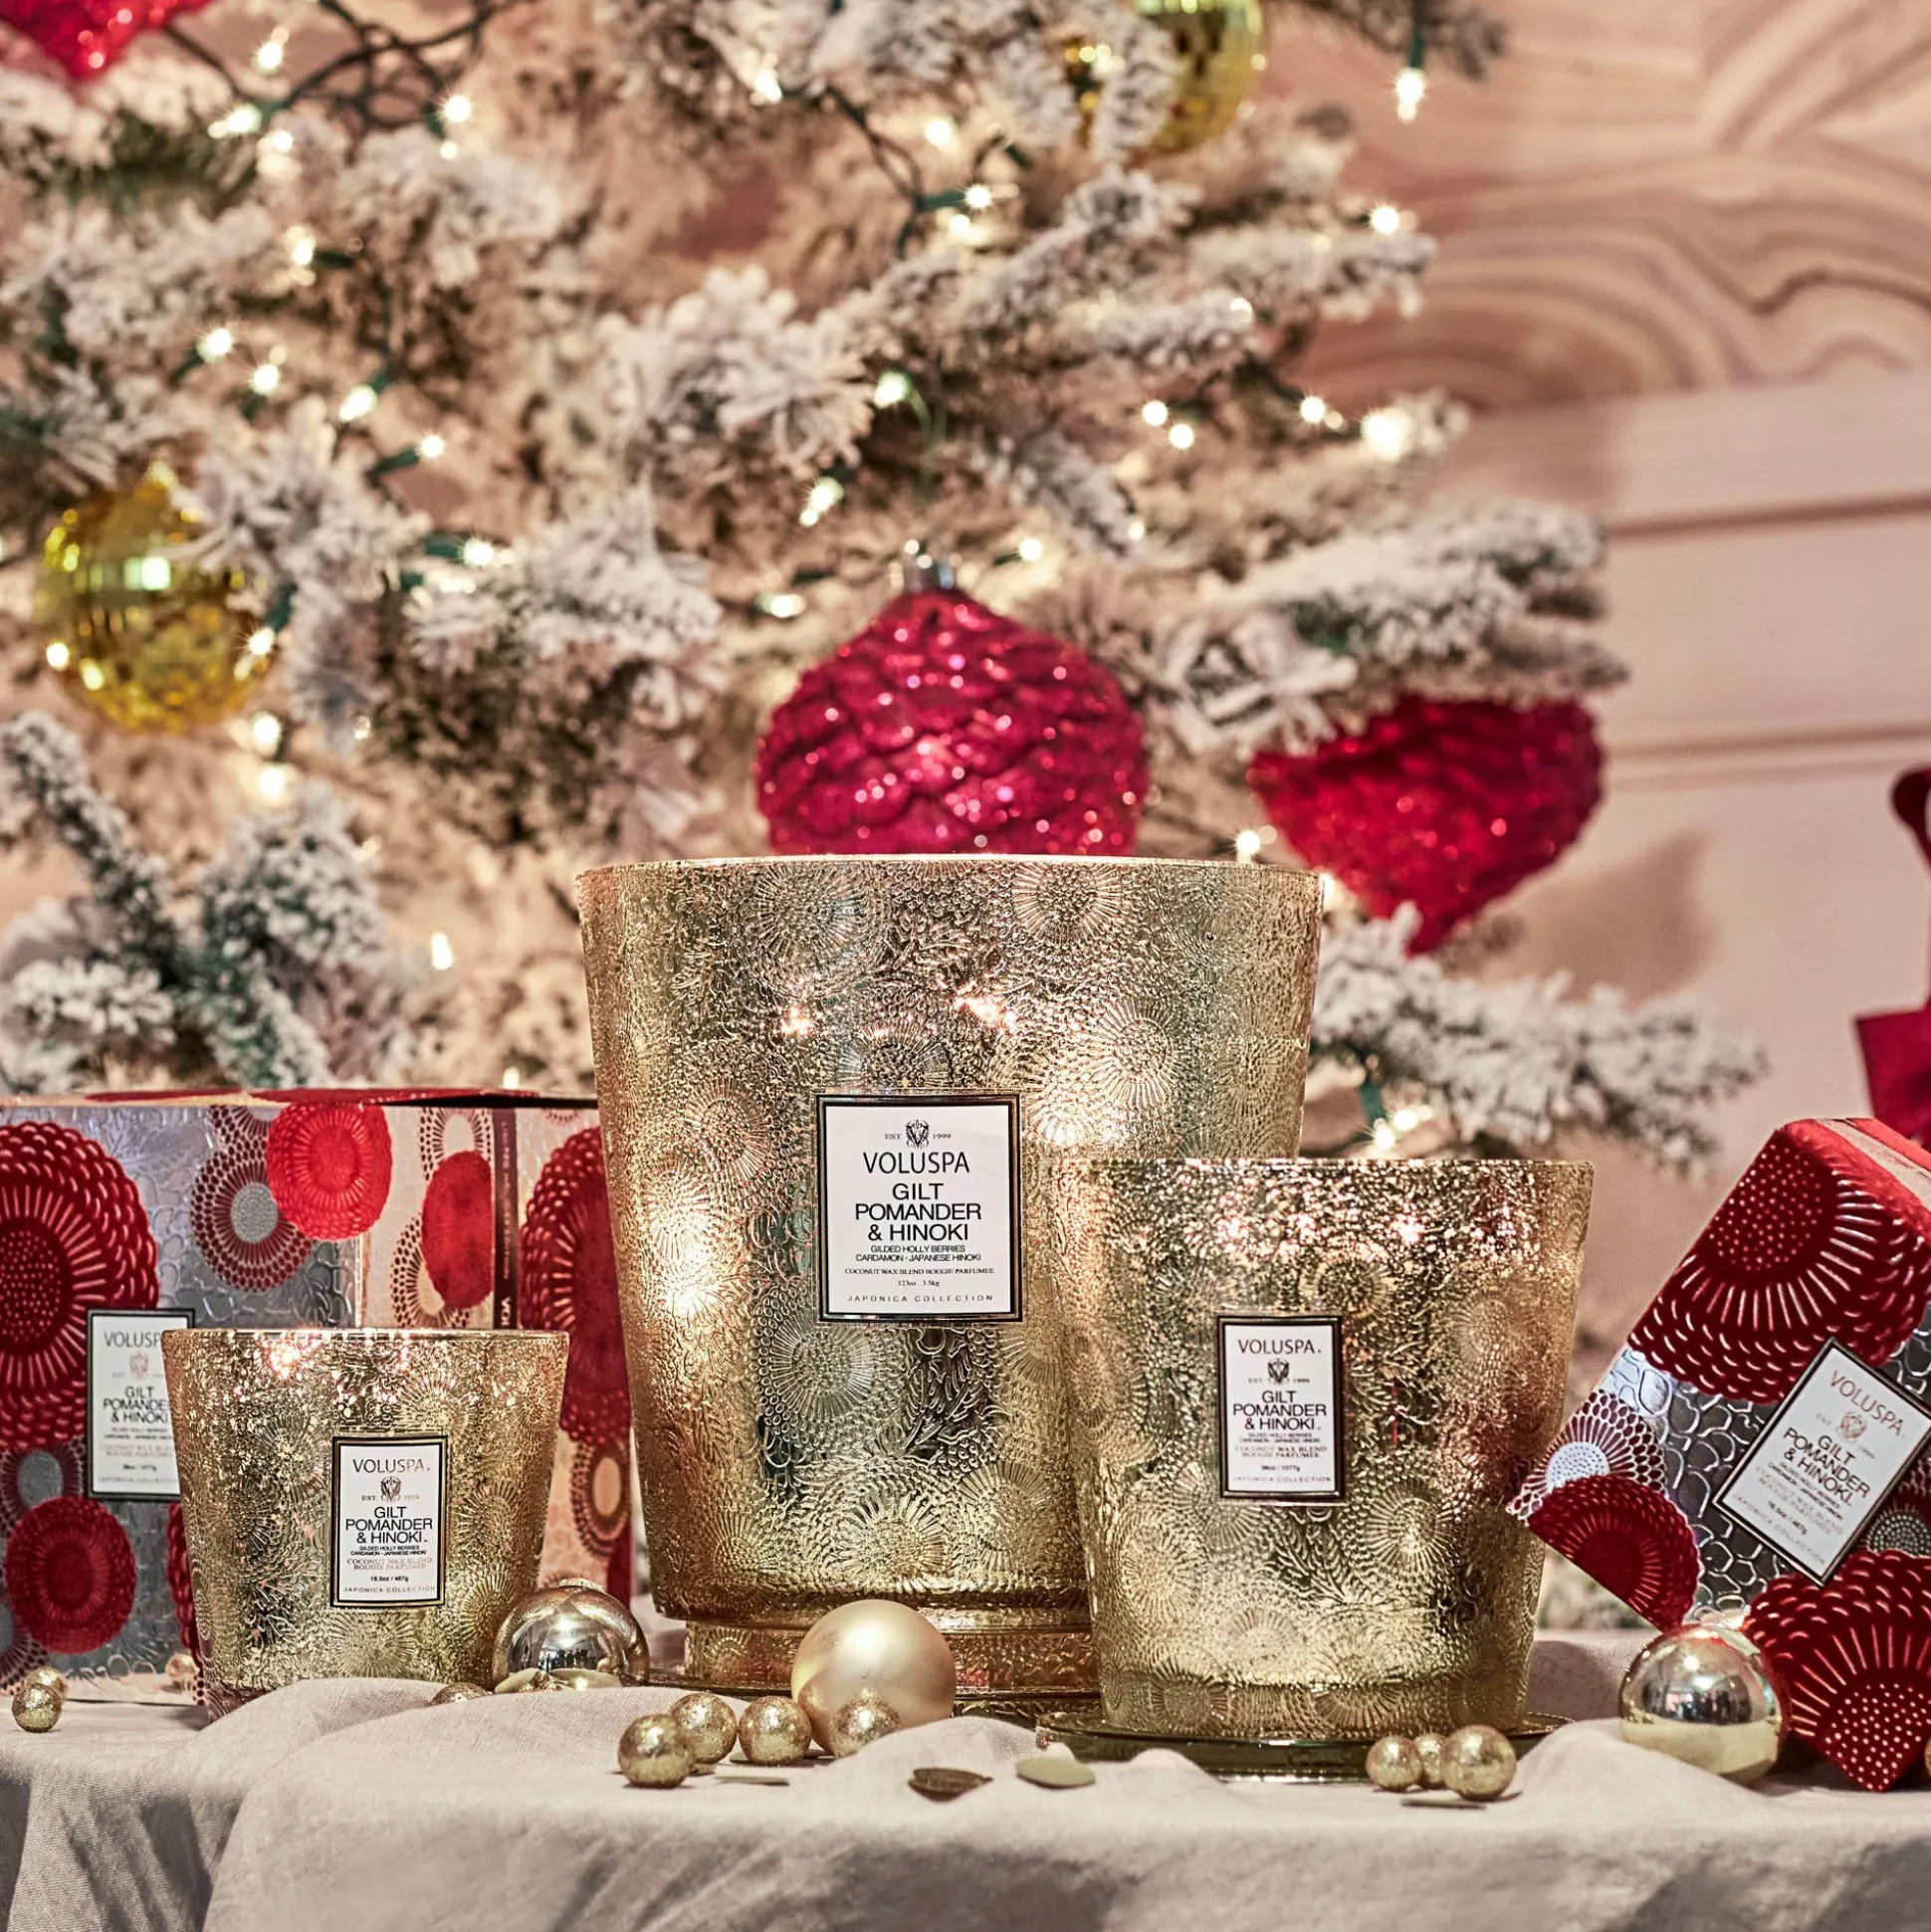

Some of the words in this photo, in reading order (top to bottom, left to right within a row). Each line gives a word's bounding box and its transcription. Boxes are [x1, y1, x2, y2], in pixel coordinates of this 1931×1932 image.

[863, 1151, 970, 1175] VOLUSPA
[892, 1182, 945, 1200] GILT
[855, 1202, 982, 1221] POMANDER
[868, 1223, 883, 1242] &
[889, 1223, 968, 1241] HINOKI
[104, 1331, 161, 1348] VOLUSP
[124, 1386, 155, 1398] GILT
[1261, 1391, 1296, 1403] GILT
[103, 1398, 170, 1411] POMANDE
[1829, 1369, 1904, 1435] VOLUSPA
[110, 1411, 120, 1423] &
[1232, 1403, 1327, 1417] POMANDER
[1244, 1417, 1255, 1430] &
[1259, 1417, 1315, 1430] HINOKI
[1784, 1448, 1797, 1463] &
[1818, 1434, 1856, 1465] GILT
[1783, 1426, 1871, 1498] POMANDER
[373, 1506, 407, 1519] GILT
[345, 1518, 433, 1531] POMANDER
[356, 1532, 367, 1544] &
[370, 1531, 422, 1544] HINOKI
